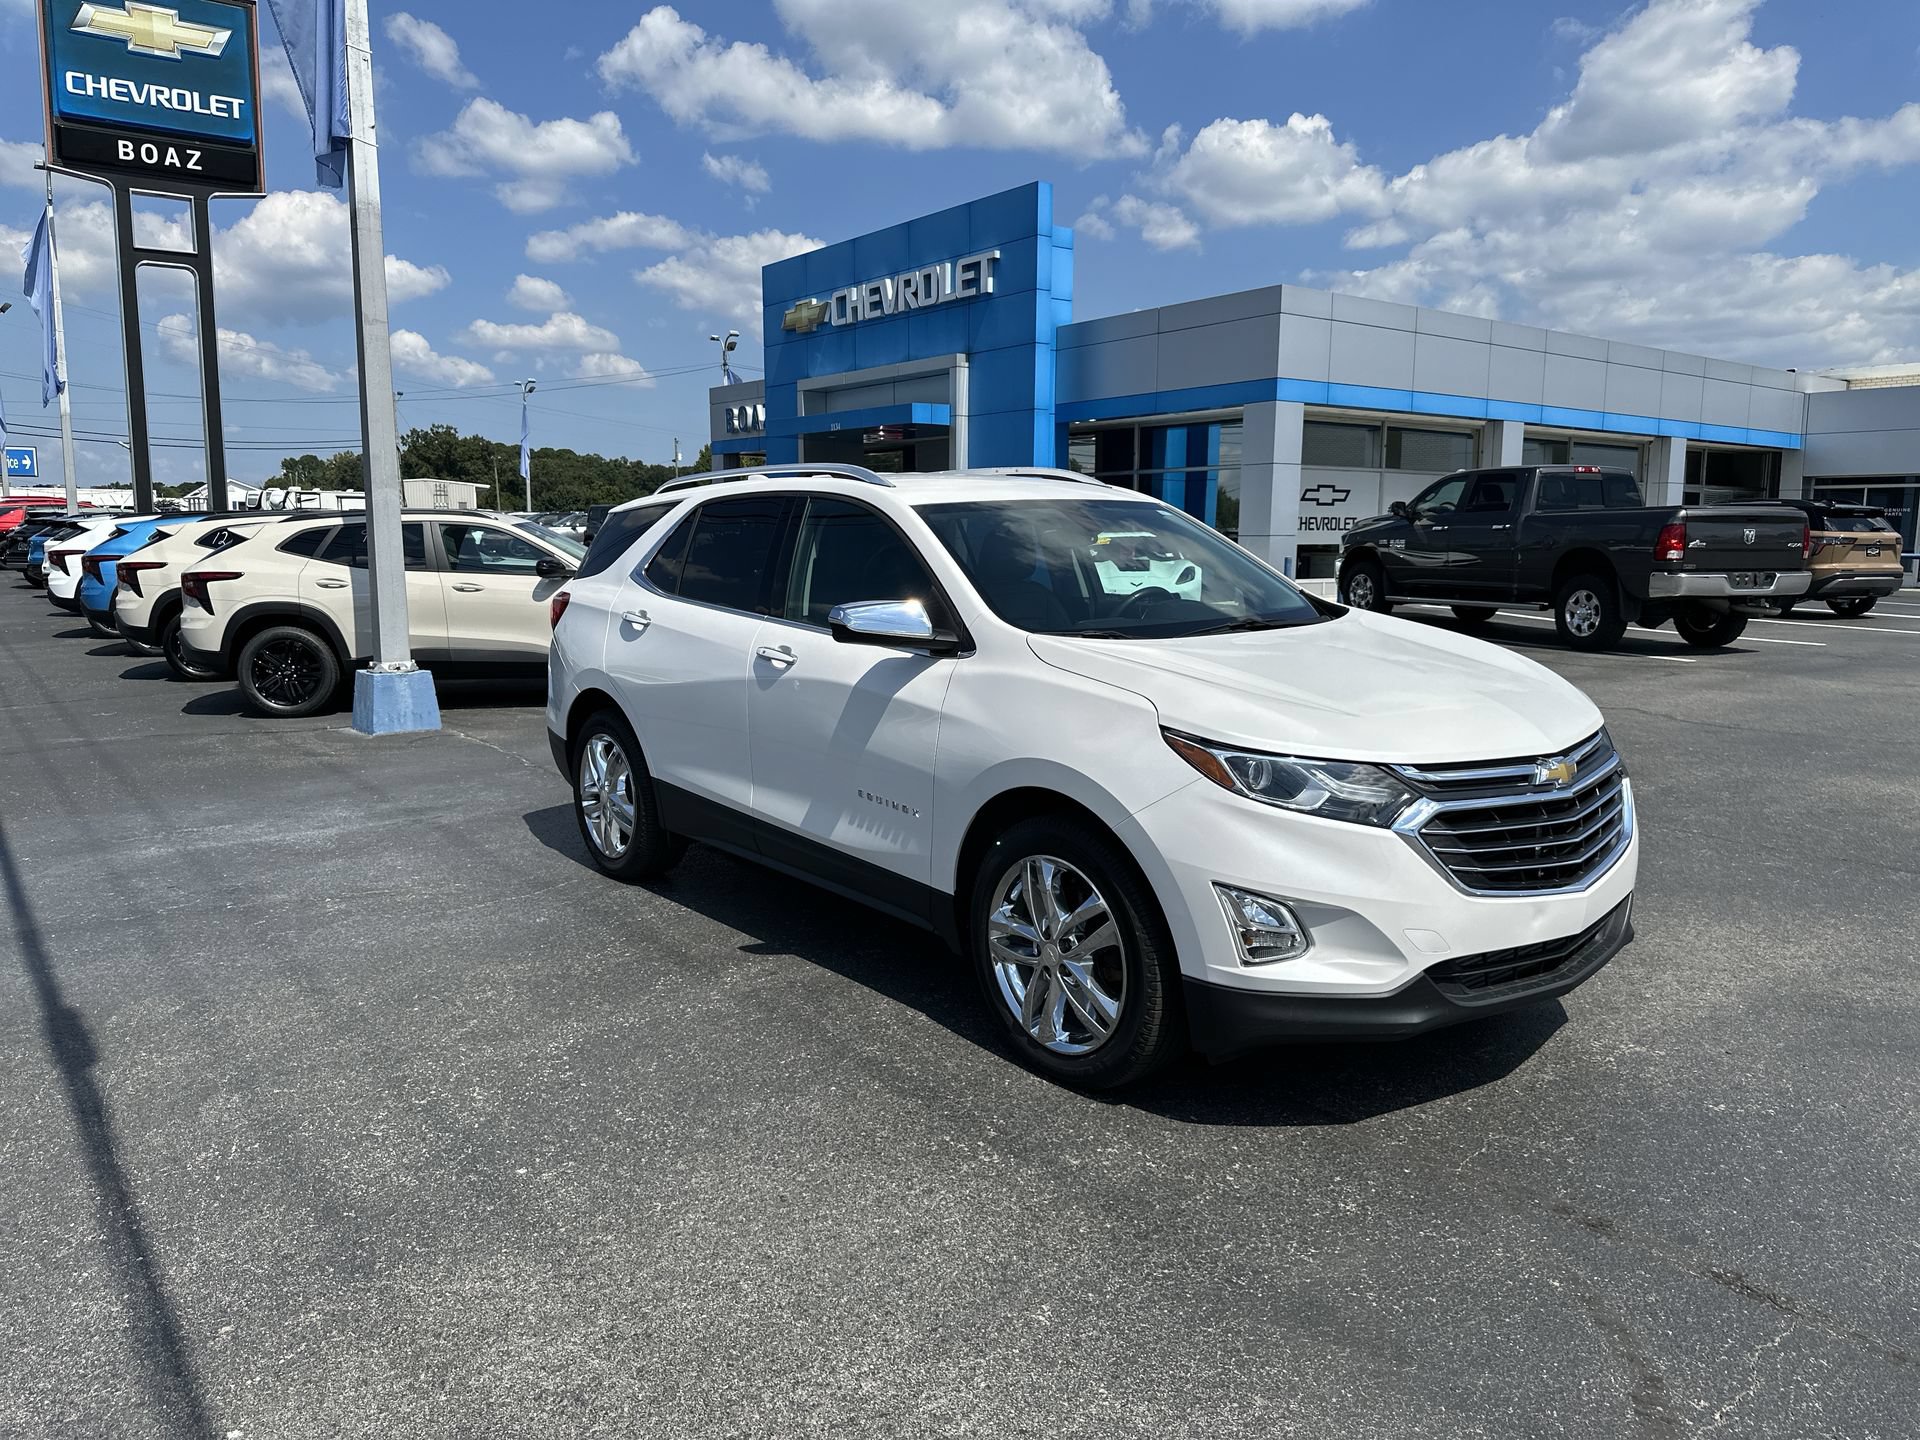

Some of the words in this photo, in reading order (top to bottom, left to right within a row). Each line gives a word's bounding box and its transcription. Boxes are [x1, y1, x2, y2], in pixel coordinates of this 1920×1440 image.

[65, 71, 244, 119] CHEVROLET
[117, 140, 203, 171] BOAZ
[831, 250, 1000, 326] CHEVROLET
[725, 404, 766, 433] BOA
[1298, 516, 1357, 531] HEVROLET
[857, 789, 920, 818] EQUINOX
